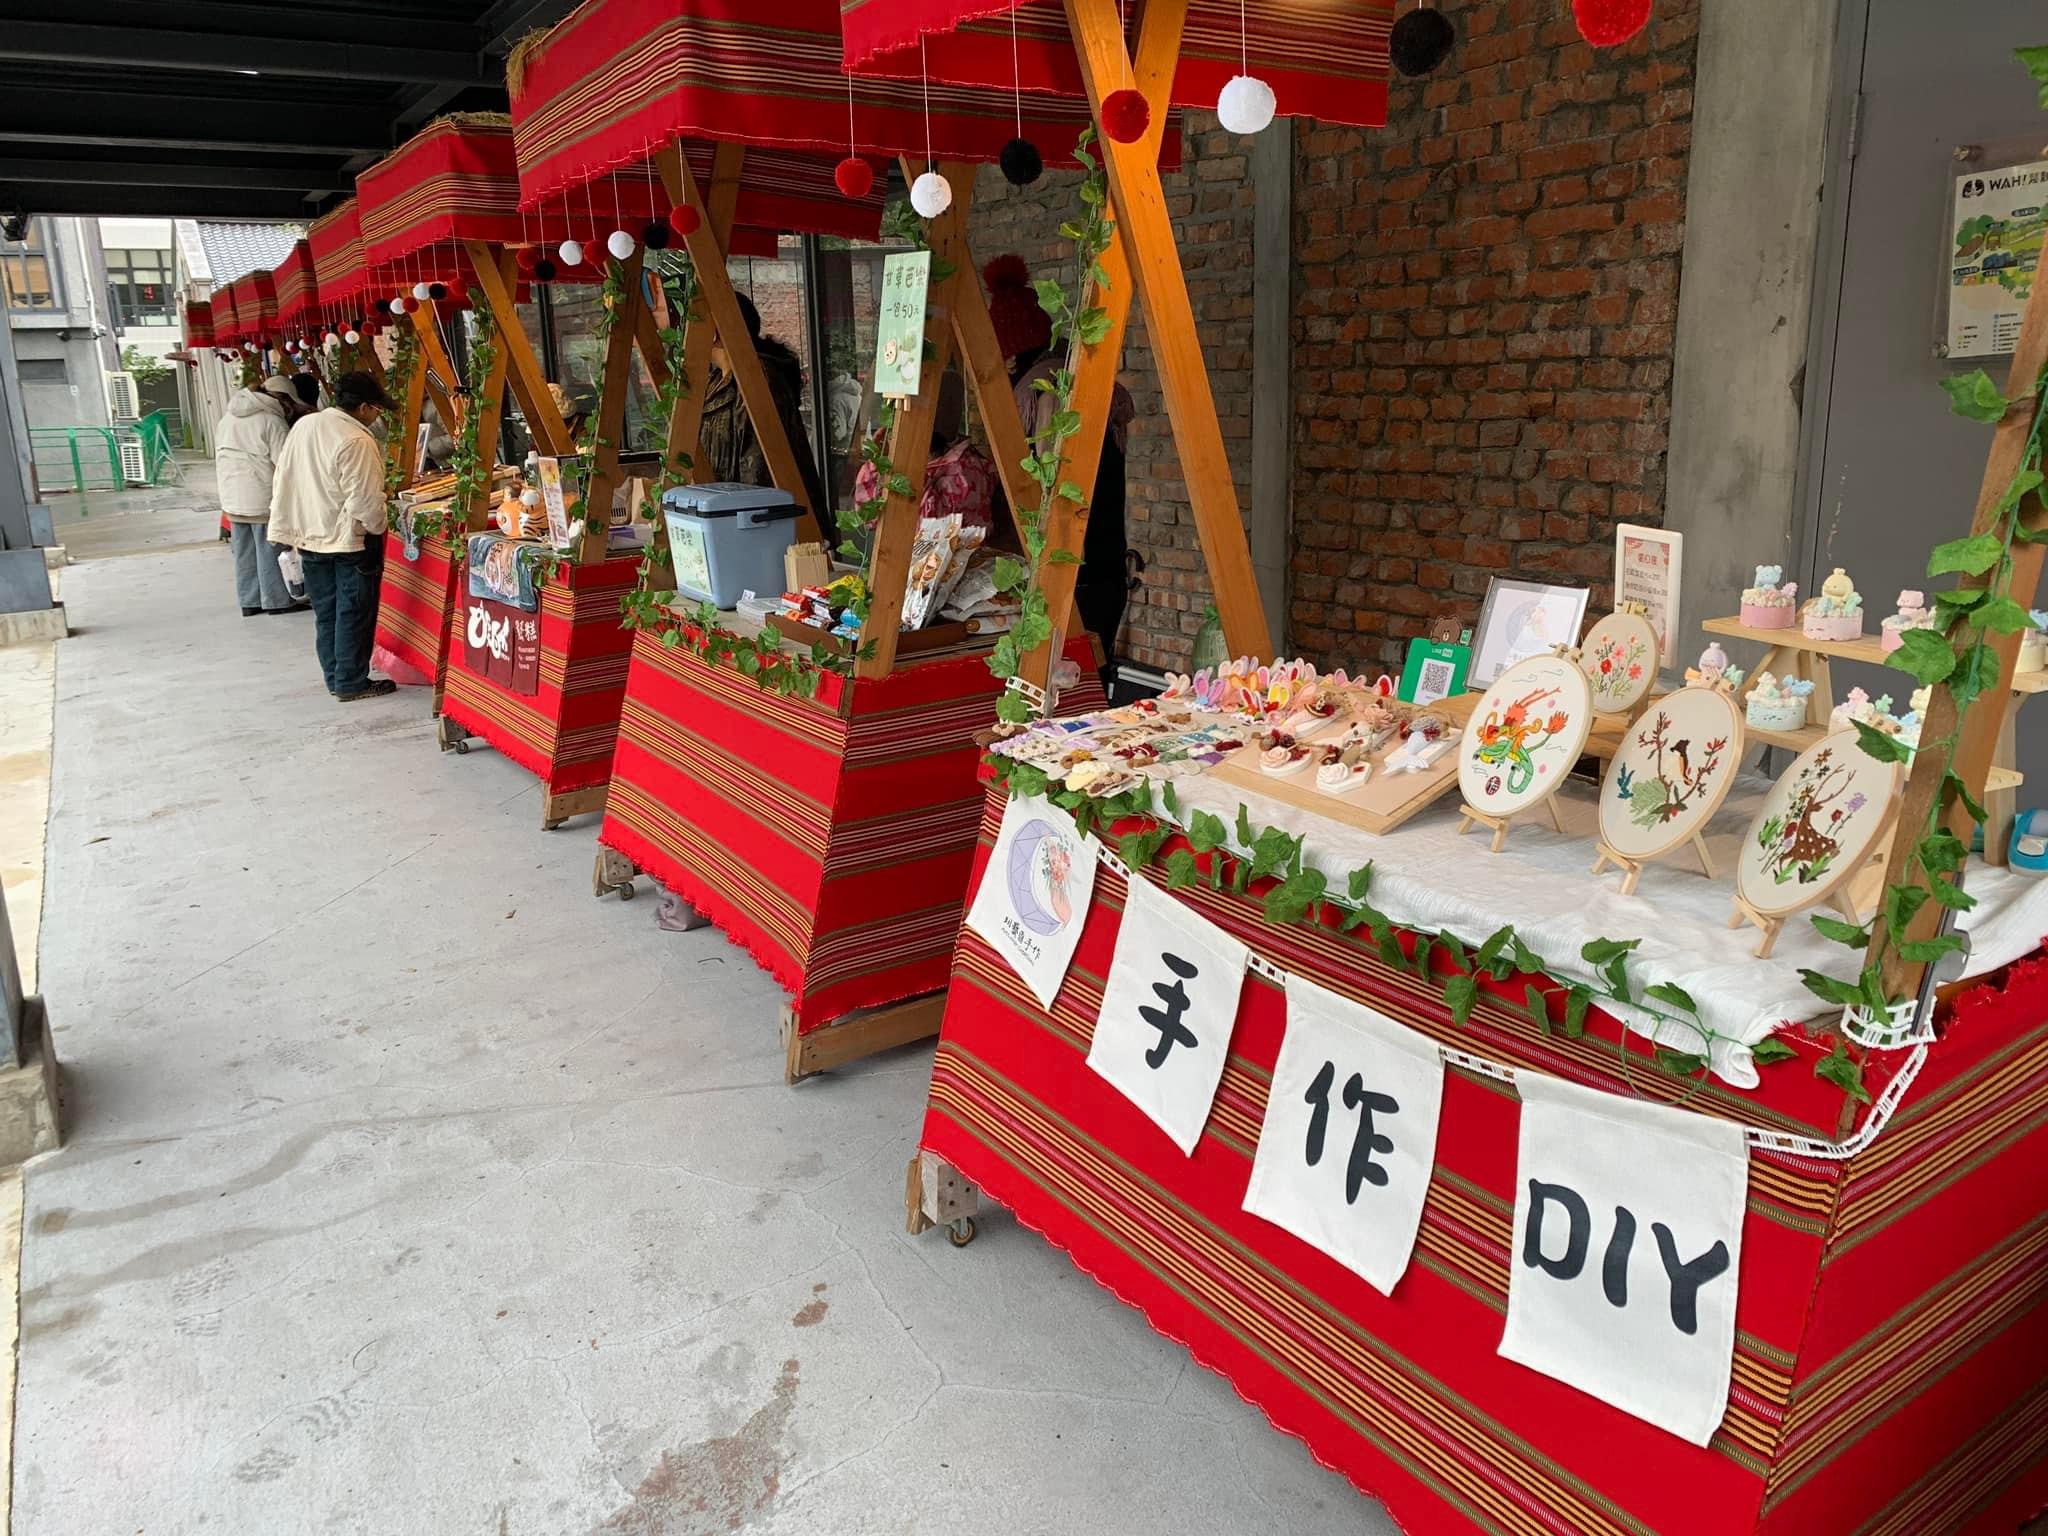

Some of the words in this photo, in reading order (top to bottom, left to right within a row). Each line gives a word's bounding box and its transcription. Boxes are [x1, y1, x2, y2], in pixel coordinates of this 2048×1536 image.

[1989, 174, 2027, 191] WAH!
[1138, 952, 1199, 1069] 手
[1304, 1060, 1400, 1205] 作
[1522, 1178, 1729, 1335] DIY
